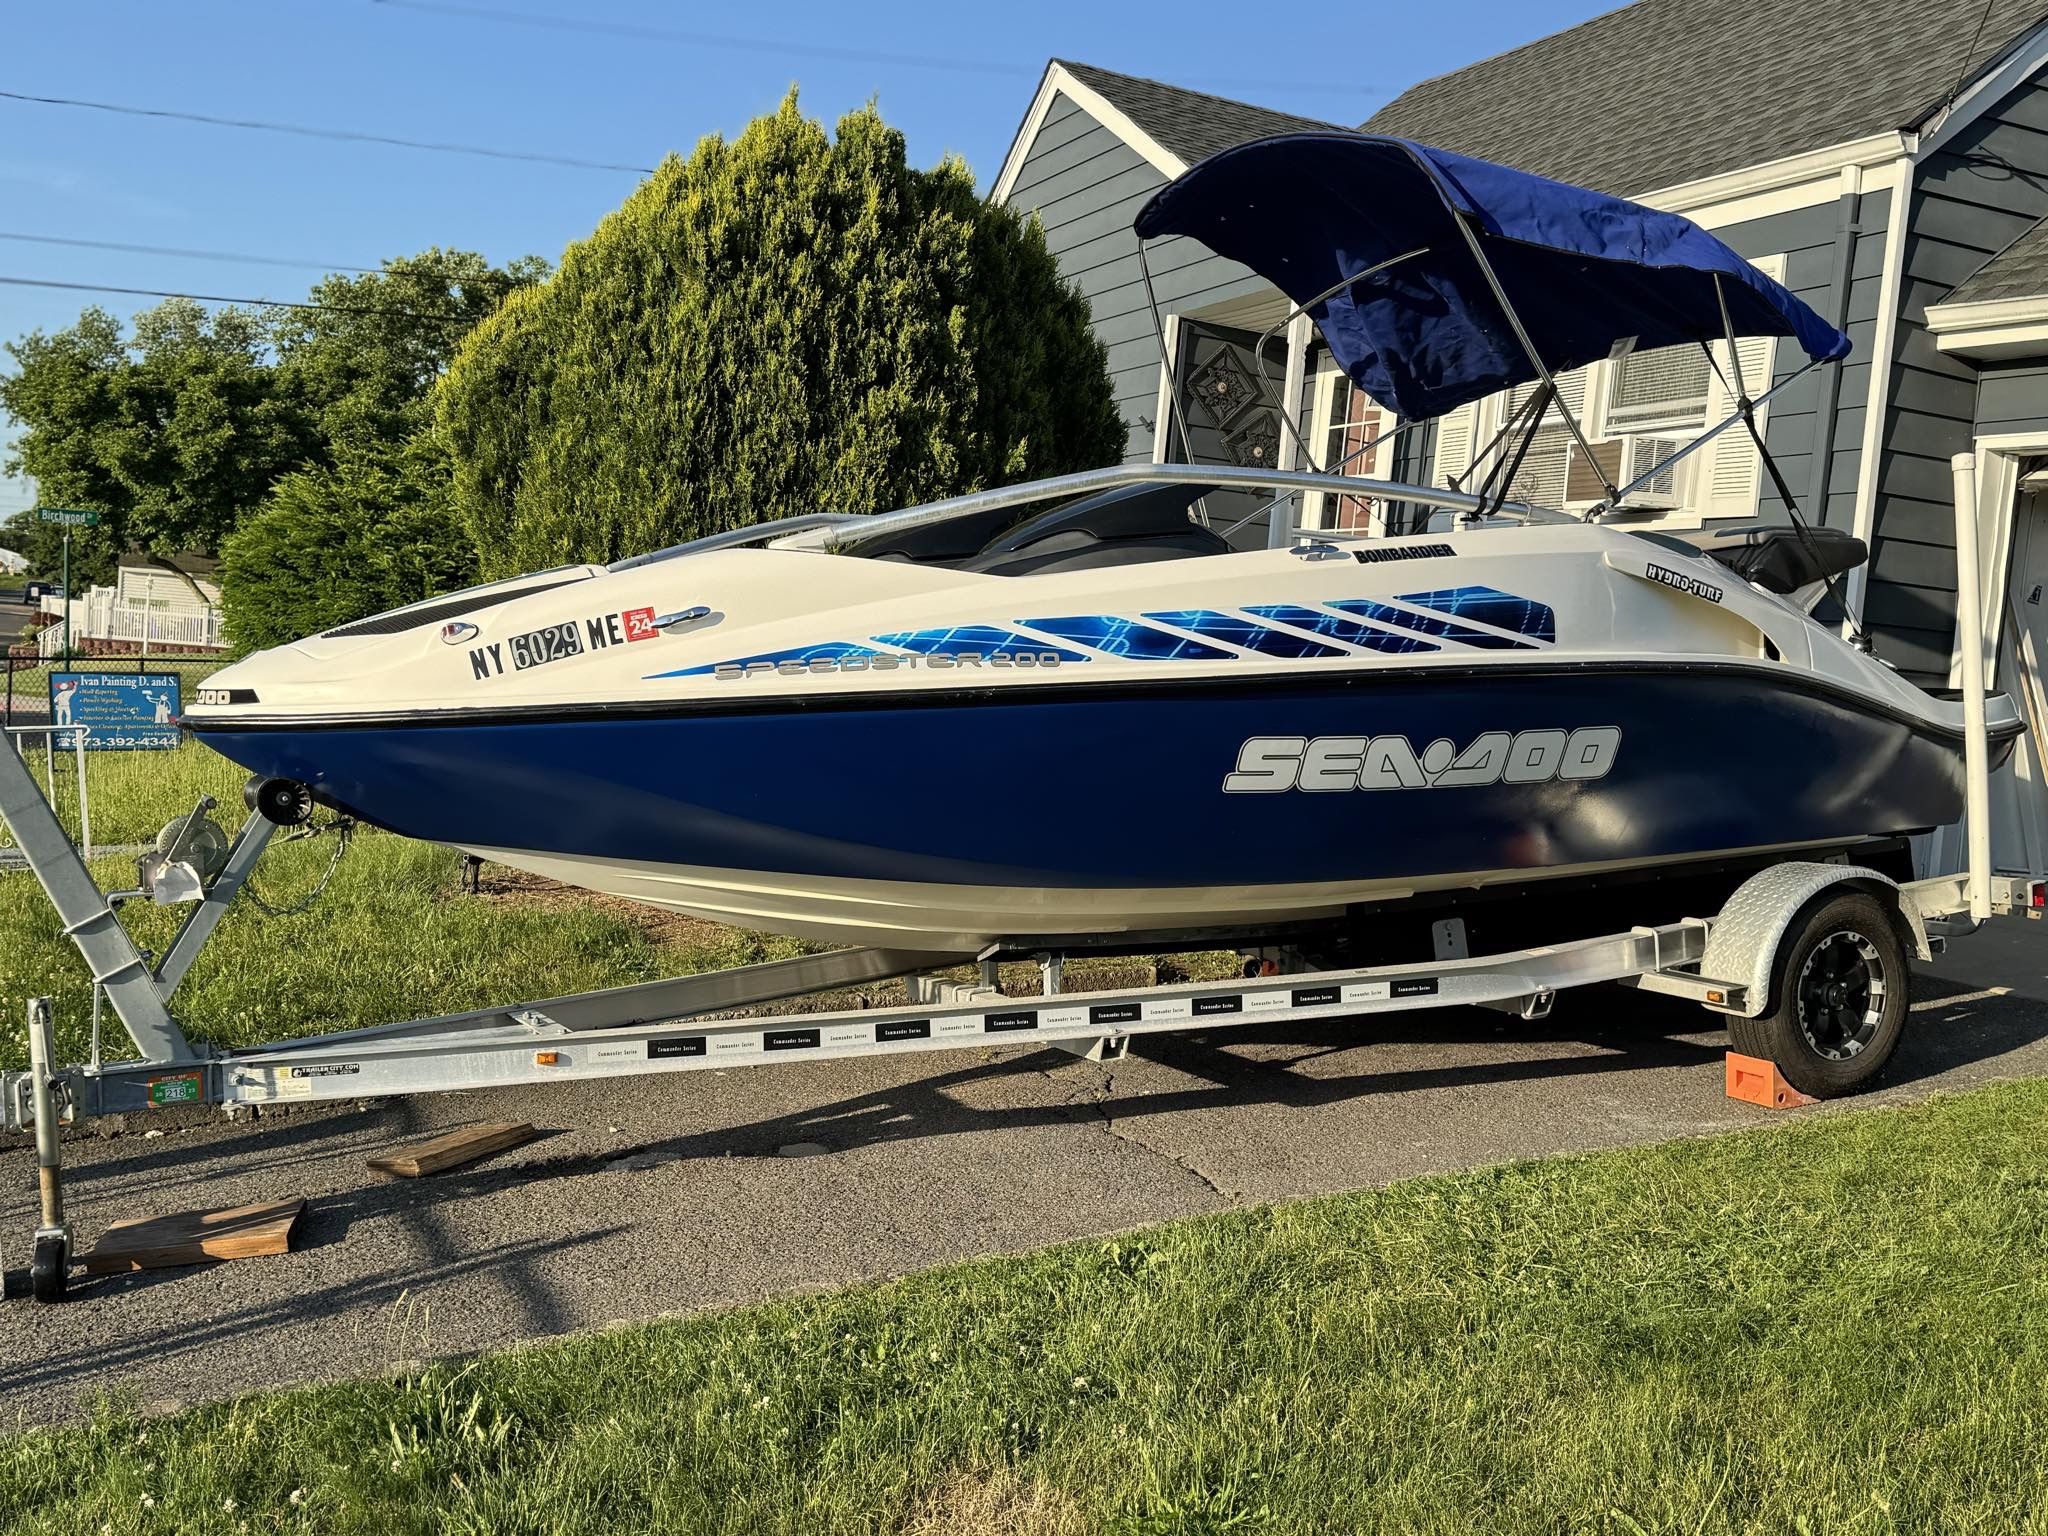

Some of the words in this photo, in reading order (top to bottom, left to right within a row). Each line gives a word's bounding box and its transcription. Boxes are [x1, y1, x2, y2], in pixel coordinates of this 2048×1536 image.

[42, 509, 86, 523] Birchwood
[1352, 543, 1458, 564] BOMBARDIER
[1647, 563, 1723, 603] HYDRO-TURF
[629, 617, 653, 635] 24
[469, 642, 504, 680] NY
[509, 621, 584, 670] 6029
[586, 613, 624, 650] ME
[715, 652, 982, 681] SPEEDSTER
[991, 651, 1063, 668] 200
[81, 675, 99, 686] Ivan
[101, 675, 137, 689] Painting
[138, 676, 149, 687] D.
[151, 676, 167, 687] and
[168, 676, 177, 687] S.
[166, 1088, 186, 1098] 218
